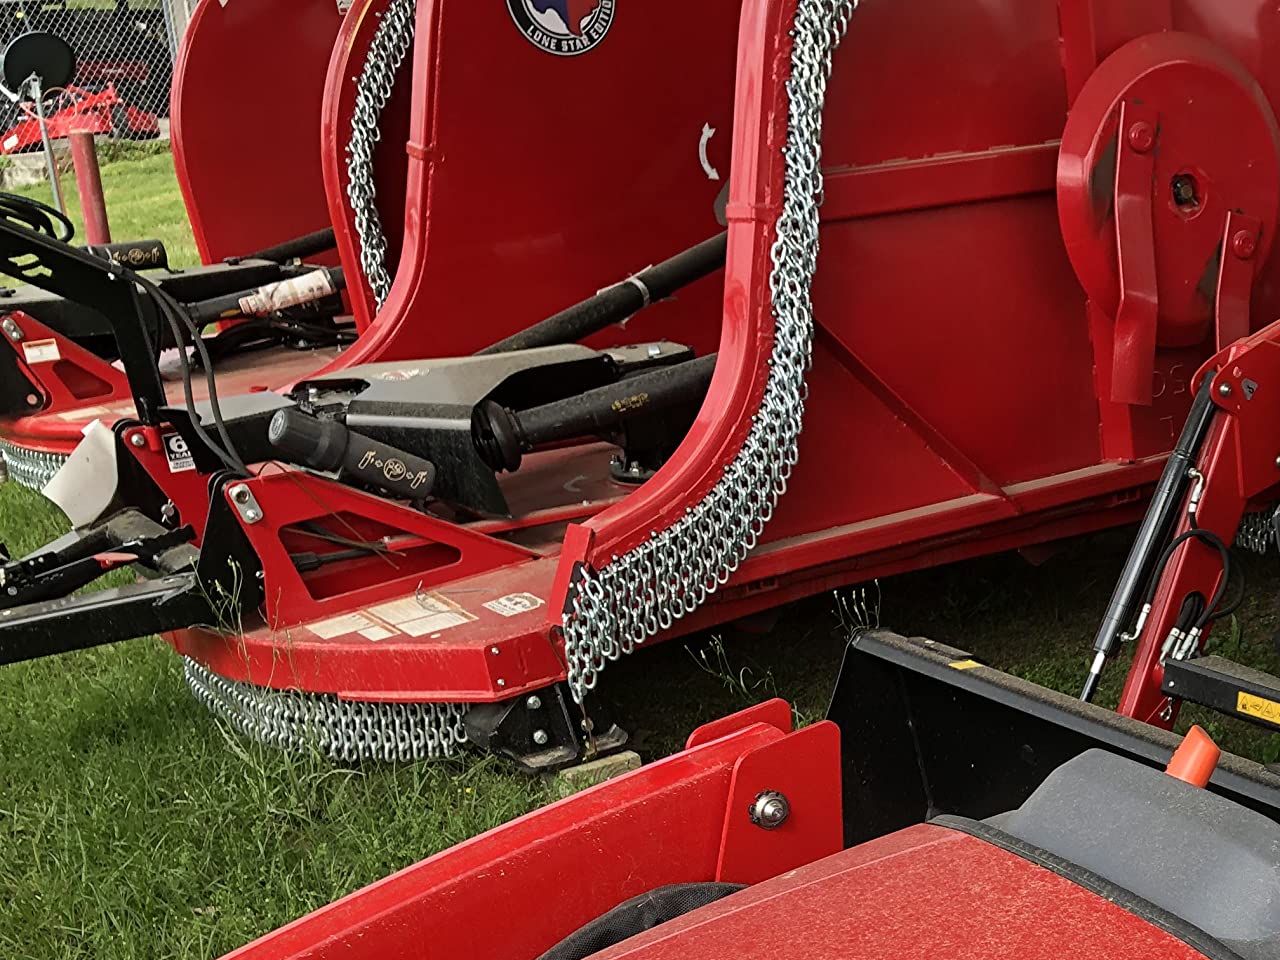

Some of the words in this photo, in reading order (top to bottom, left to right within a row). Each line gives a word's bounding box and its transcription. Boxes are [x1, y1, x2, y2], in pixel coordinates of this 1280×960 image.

[527, 25, 557, 50] LONE
[561, 36, 590, 52] STAR
[169, 435, 188, 453] 6
